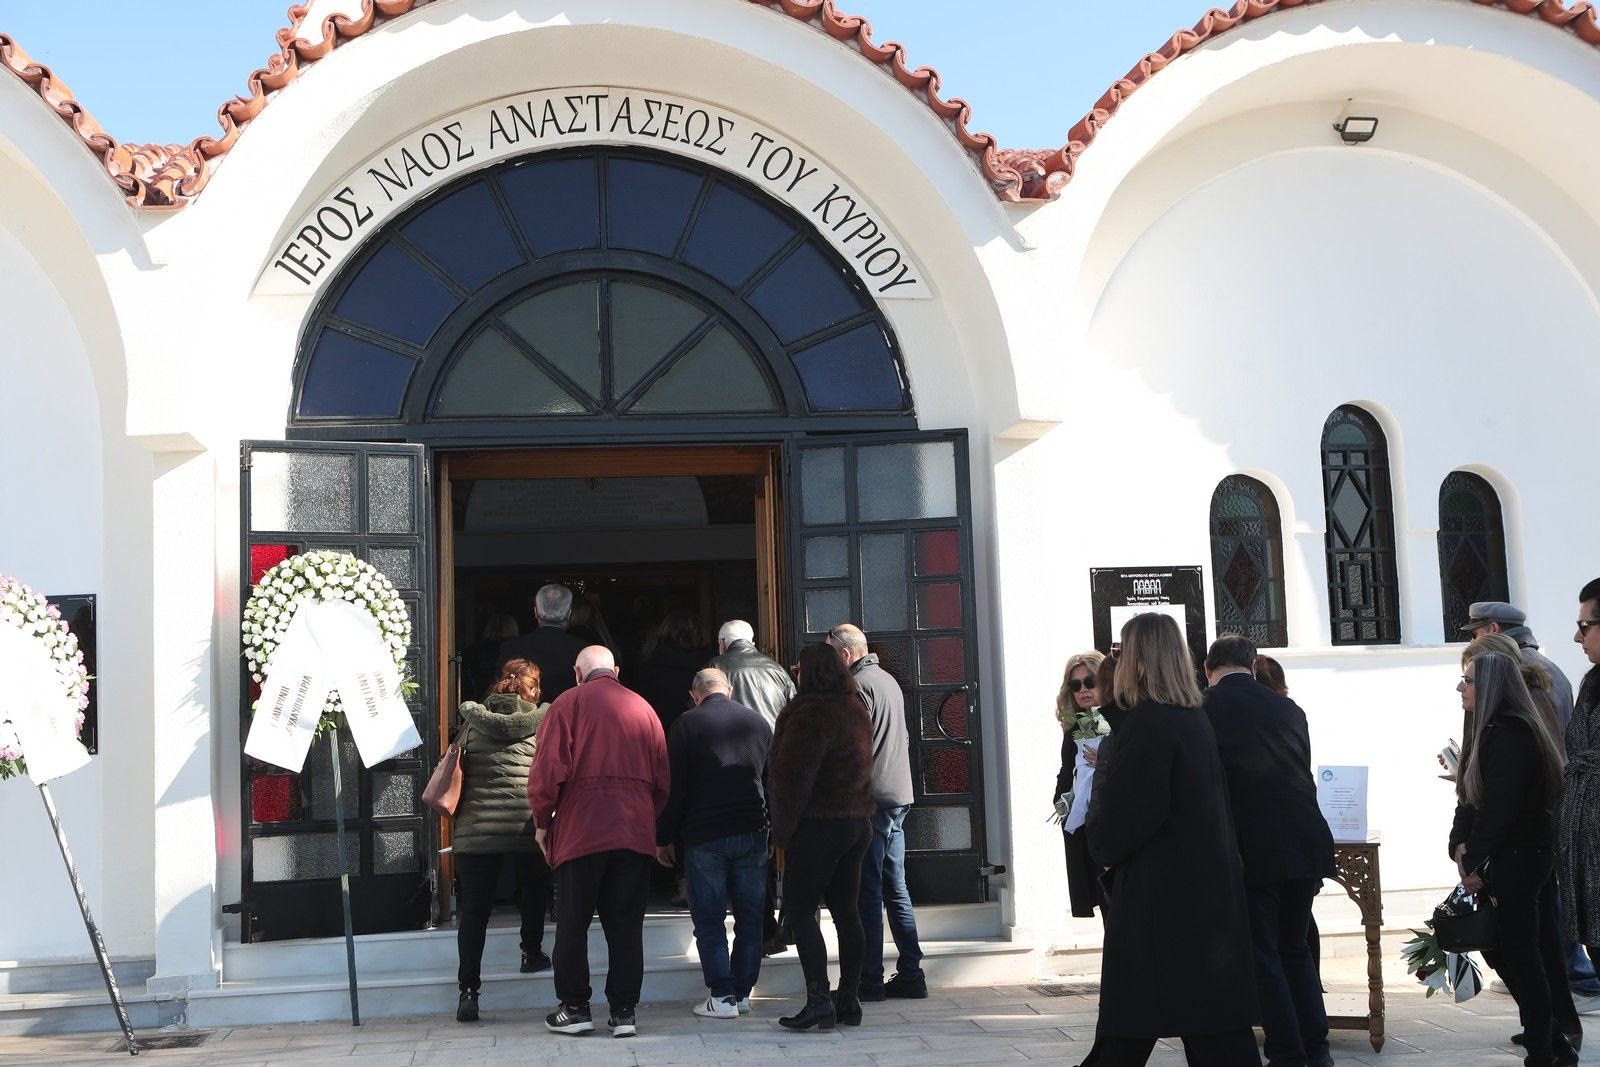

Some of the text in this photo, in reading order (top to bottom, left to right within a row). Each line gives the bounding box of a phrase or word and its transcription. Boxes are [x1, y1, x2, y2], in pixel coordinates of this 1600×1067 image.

[275, 94, 917, 293] ΙΕΡΟΣ ΝΑΟΣ ΑΝΑΣΤΑΣΕΩΣ ΤΟΥ ΚΥΡΙΟΥ
